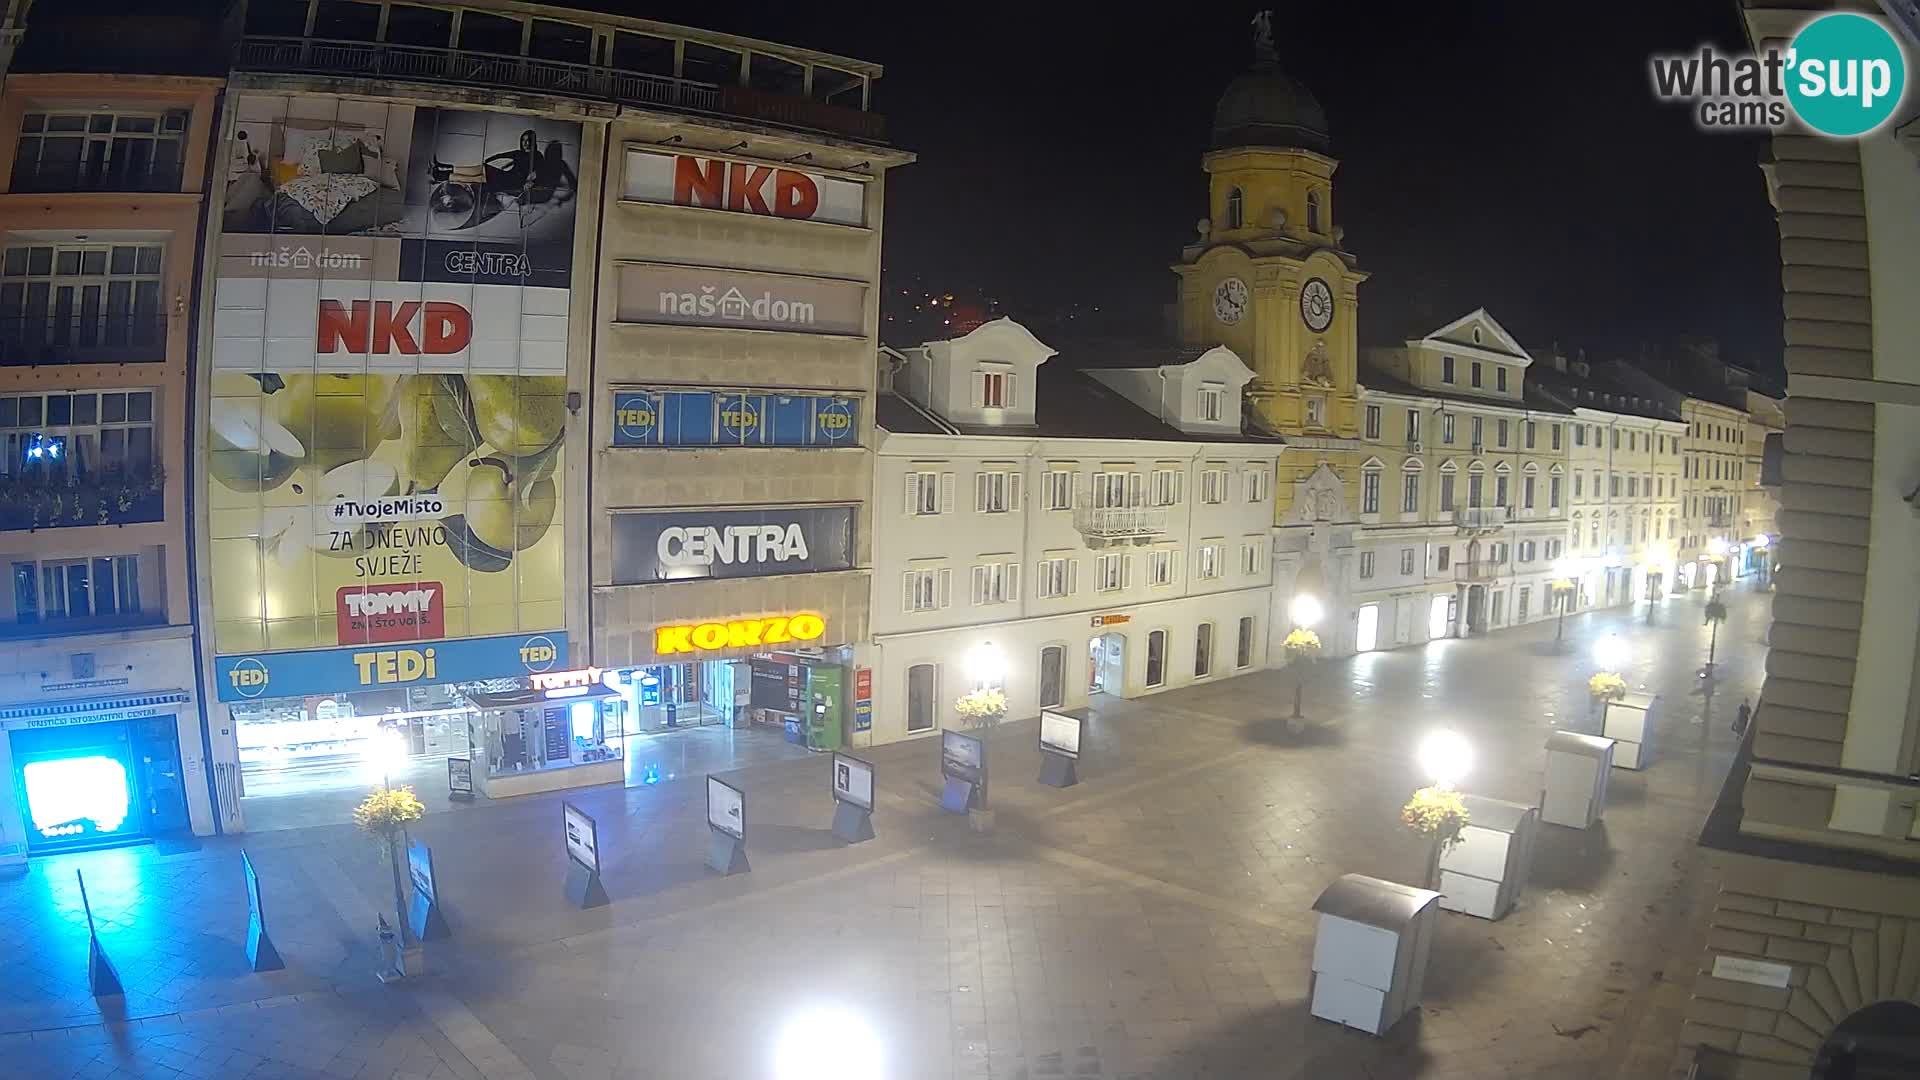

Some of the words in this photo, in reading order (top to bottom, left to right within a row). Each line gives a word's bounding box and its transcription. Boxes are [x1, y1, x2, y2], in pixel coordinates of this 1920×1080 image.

[674, 154, 819, 219] NKD
[250, 246, 289, 269] naš
[315, 248, 361, 269] dom
[444, 251, 532, 276] CENTRA
[659, 285, 716, 318] naš
[752, 291, 815, 323] dom
[316, 299, 474, 355] NKD
[616, 409, 656, 427] TEDi
[721, 410, 758, 428] TEDi
[818, 412, 851, 430] TEDi
[334, 499, 443, 518] #TvojeMisto
[329, 531, 354, 551] ZA
[364, 526, 447, 550] DNEVNO
[657, 523, 809, 565] CENTRA
[355, 549, 423, 577] SVJEŽE
[344, 589, 436, 617] TOMMY
[656, 614, 825, 655] KORZO
[353, 648, 436, 686] TEDi
[519, 645, 557, 664] TEDi
[229, 668, 269, 688] TEDi
